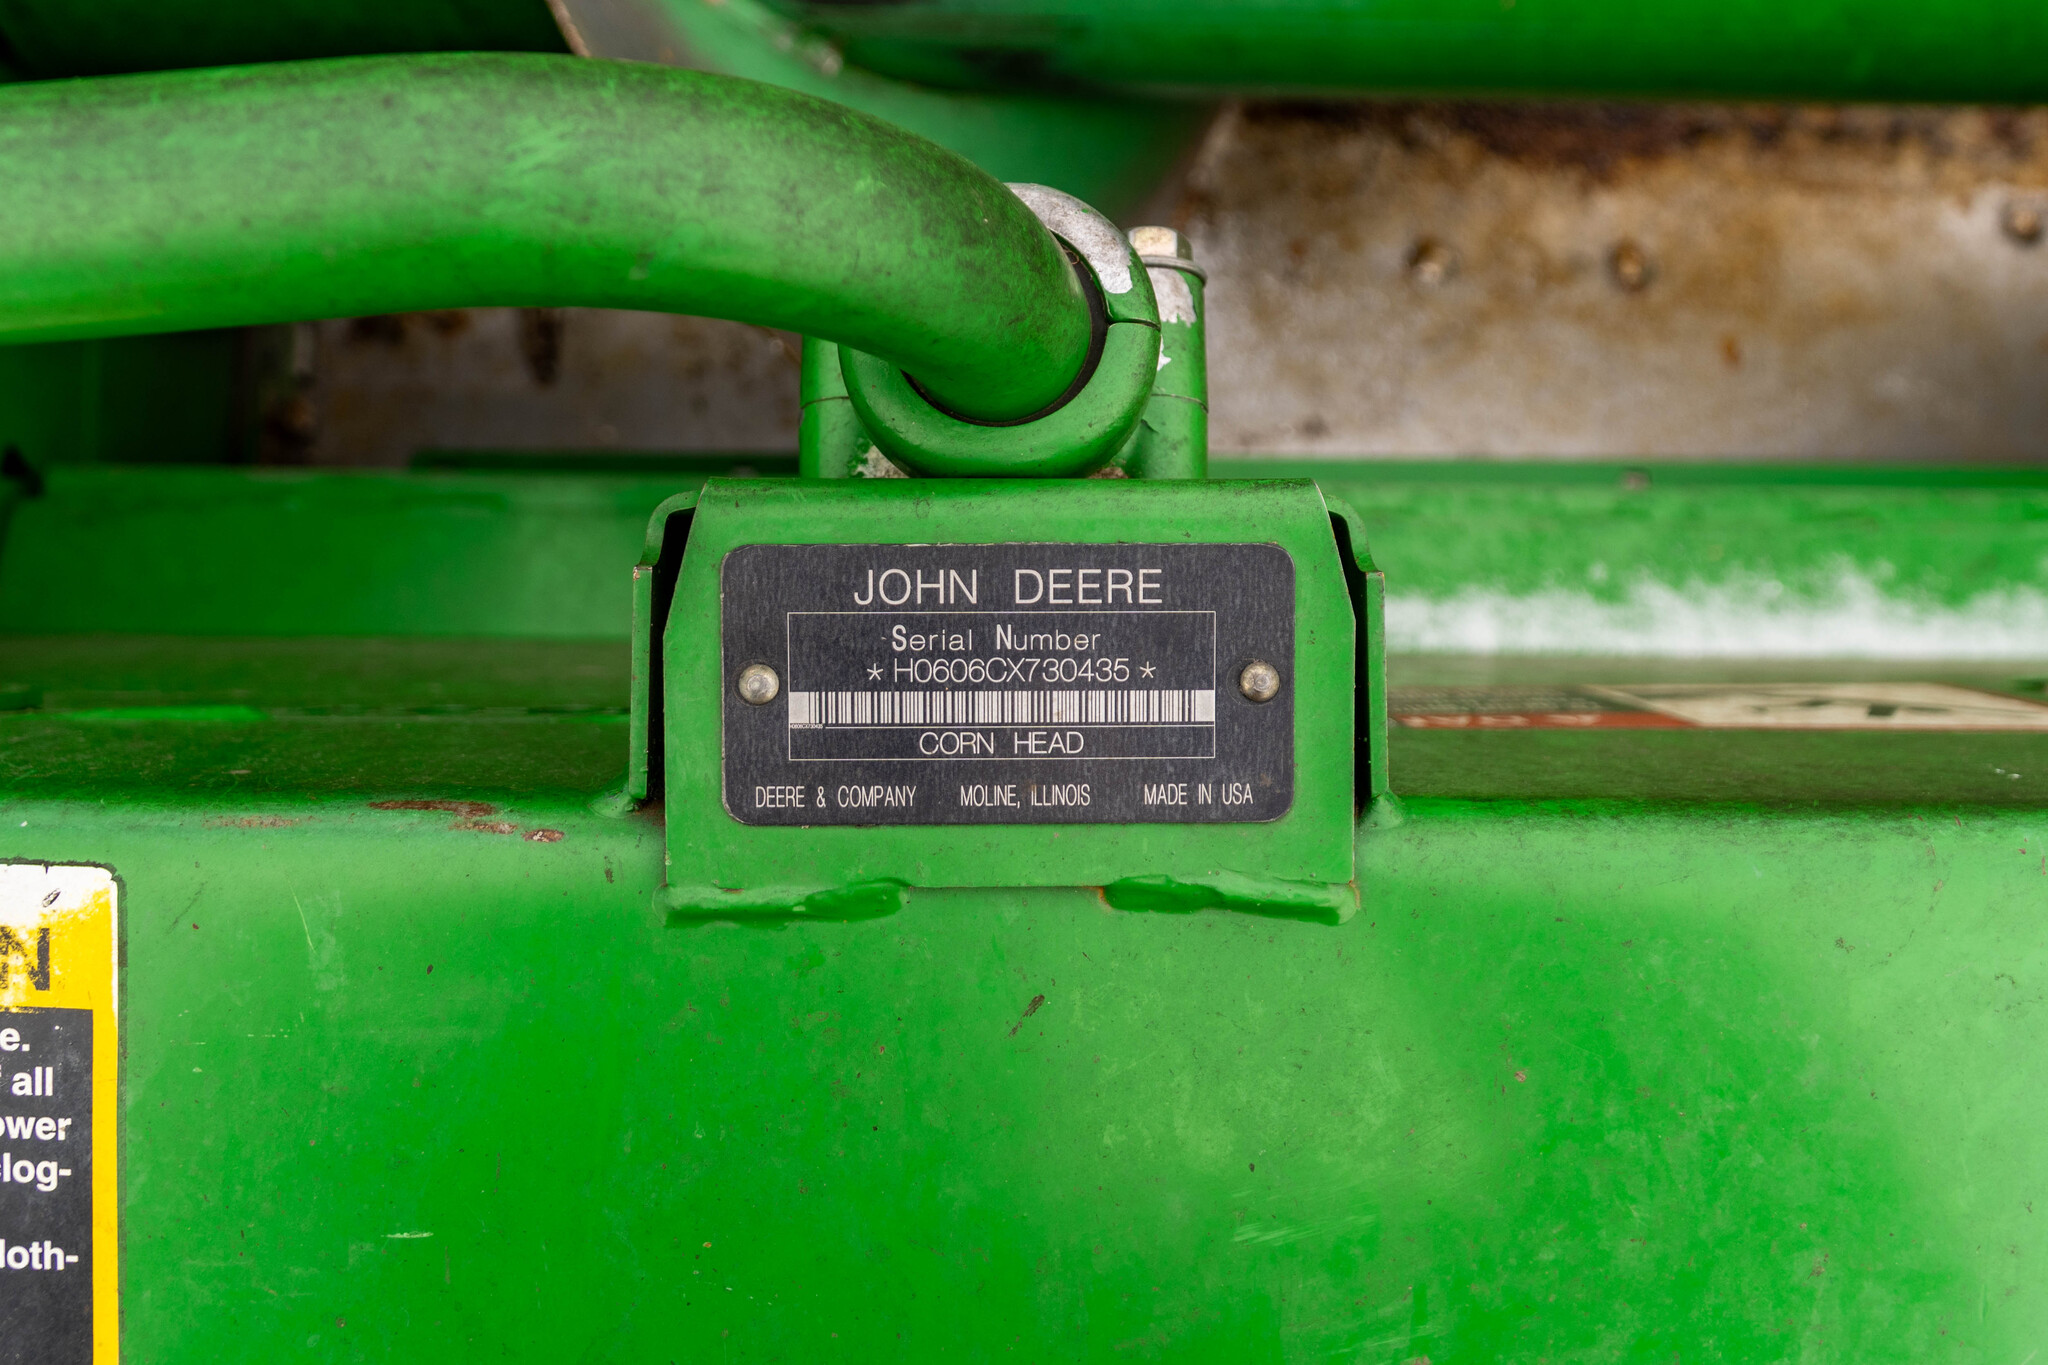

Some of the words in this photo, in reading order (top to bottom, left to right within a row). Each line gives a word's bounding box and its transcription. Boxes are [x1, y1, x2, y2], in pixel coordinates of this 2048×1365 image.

[853, 568, 978, 606] JOHN
[1014, 568, 1163, 605] DEERE
[891, 624, 973, 652] Serial
[996, 624, 1101, 651] Number
[893, 656, 1130, 684] H0606CX730435
[918, 731, 995, 756] CORN
[1013, 731, 1085, 755] HEAD
[755, 785, 806, 809] DEERE
[816, 785, 827, 808] &
[837, 784, 917, 809] COMPANY
[960, 784, 1021, 810] MOLINE,
[1030, 783, 1091, 807] ILLINOIS
[1143, 782, 1188, 806] MADE
[1198, 782, 1212, 805] IN
[1221, 782, 1254, 806] USA
[11, 1065, 54, 1097] all
[0, 1115, 72, 1142] wer
[0, 1152, 72, 1192] log-
